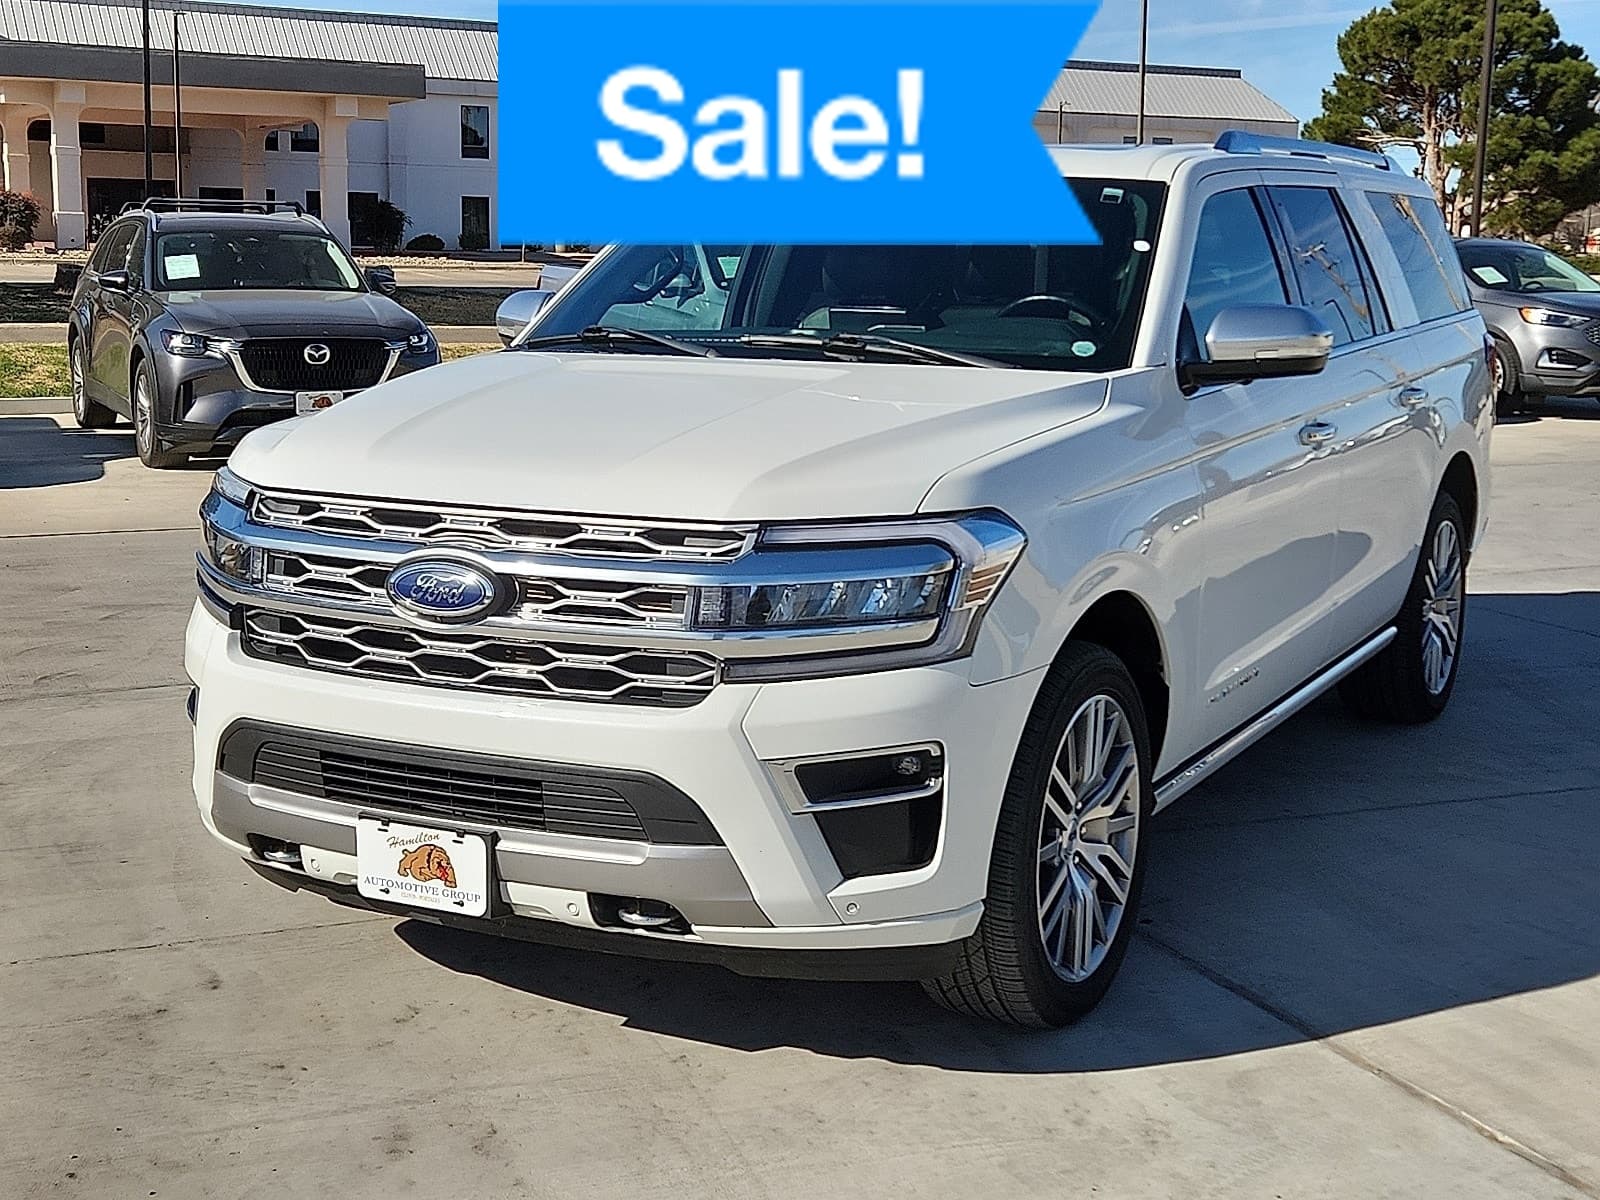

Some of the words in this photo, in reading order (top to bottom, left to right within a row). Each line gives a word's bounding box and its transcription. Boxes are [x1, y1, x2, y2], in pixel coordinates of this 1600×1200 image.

[410, 573, 466, 604] Ford
[386, 831, 440, 849] Hamilton
[364, 875, 439, 896] AUTOMOTIVE
[441, 888, 481, 902] GROUP
